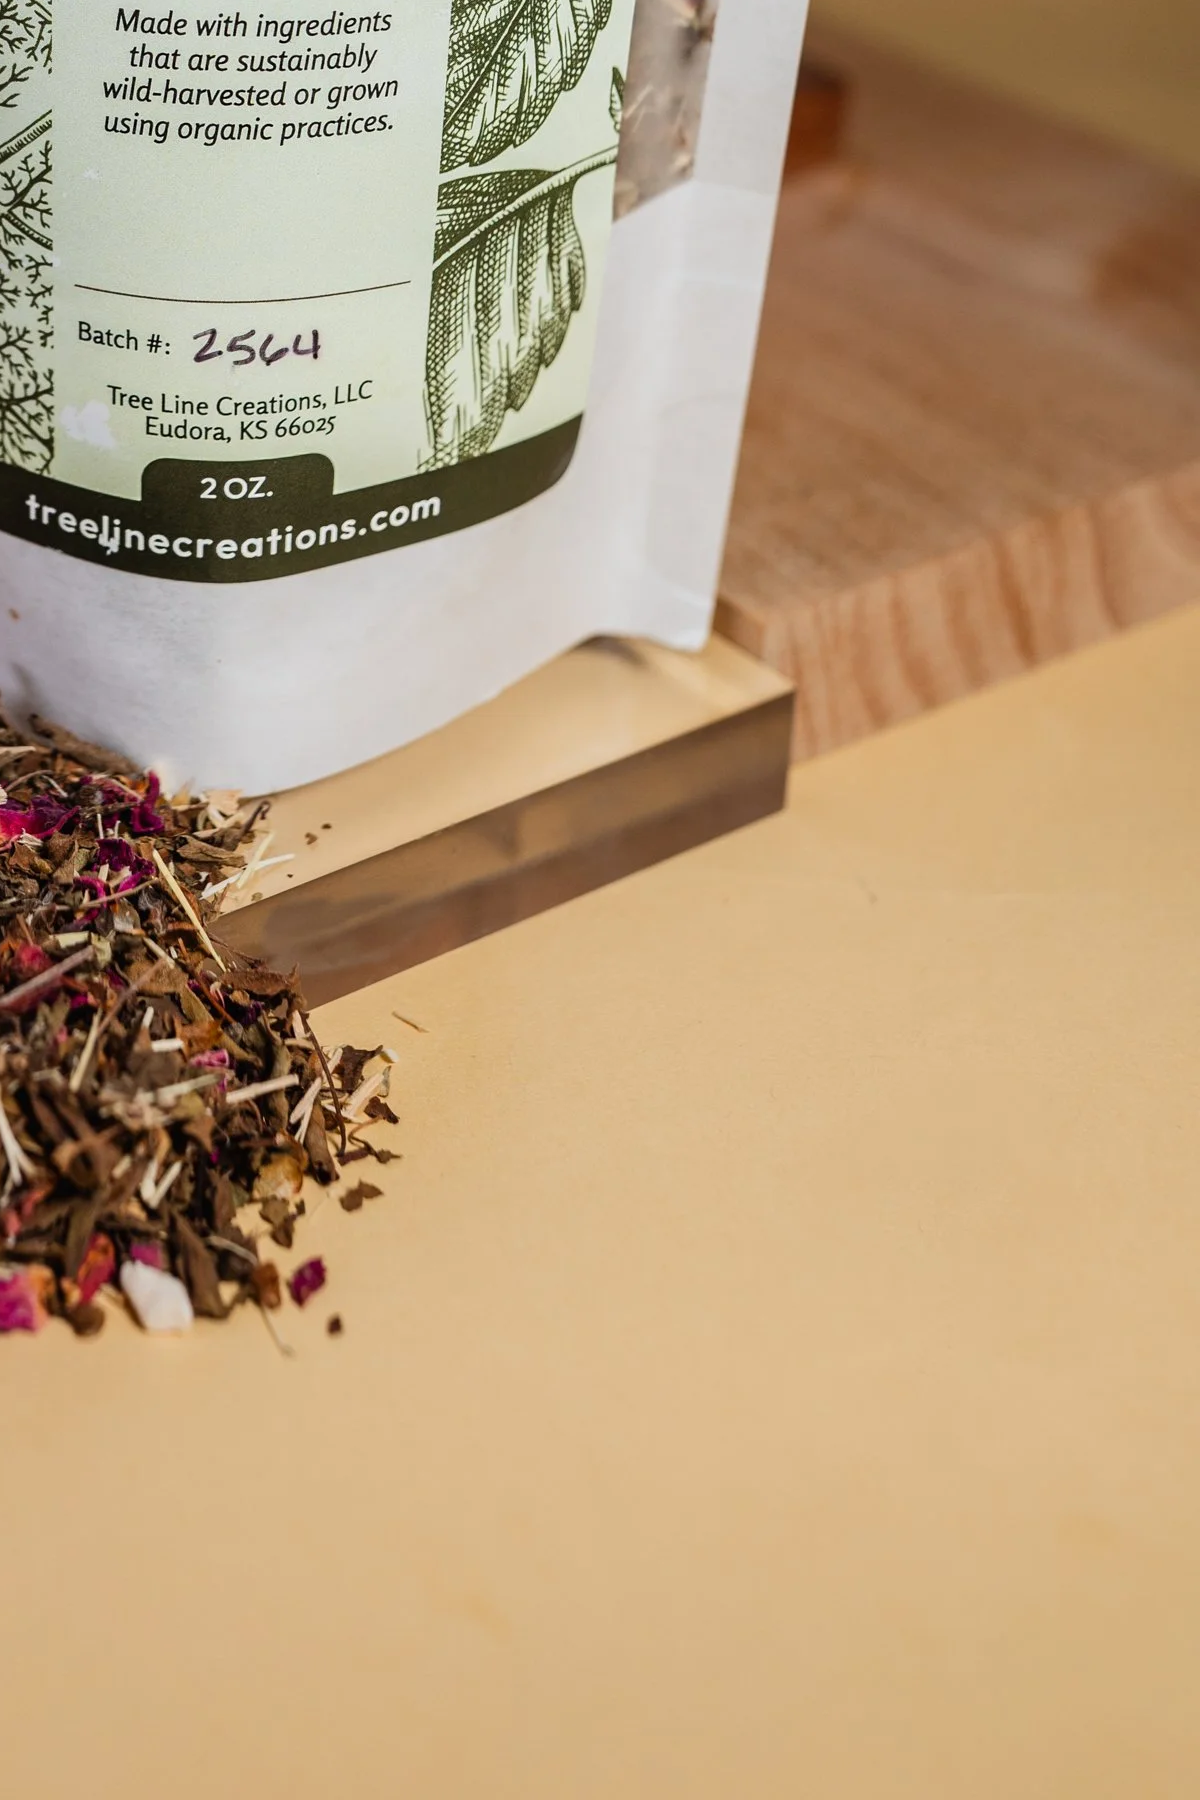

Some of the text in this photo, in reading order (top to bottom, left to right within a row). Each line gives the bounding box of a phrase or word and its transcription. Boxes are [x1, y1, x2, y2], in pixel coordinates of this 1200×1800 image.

[115, 7, 392, 44] Made with ingredients
[129, 42, 377, 74] that are sustainably
[102, 77, 399, 110] wild-harvested or grown
[104, 111, 394, 146] using organic practices.
[77, 320, 172, 355] Batch #:
[191, 327, 321, 366] 2564
[106, 379, 373, 417] Tree Line Creations, LLC
[144, 414, 337, 443] Eudora, KS 66025
[199, 476, 274, 499] 2 OZ.
